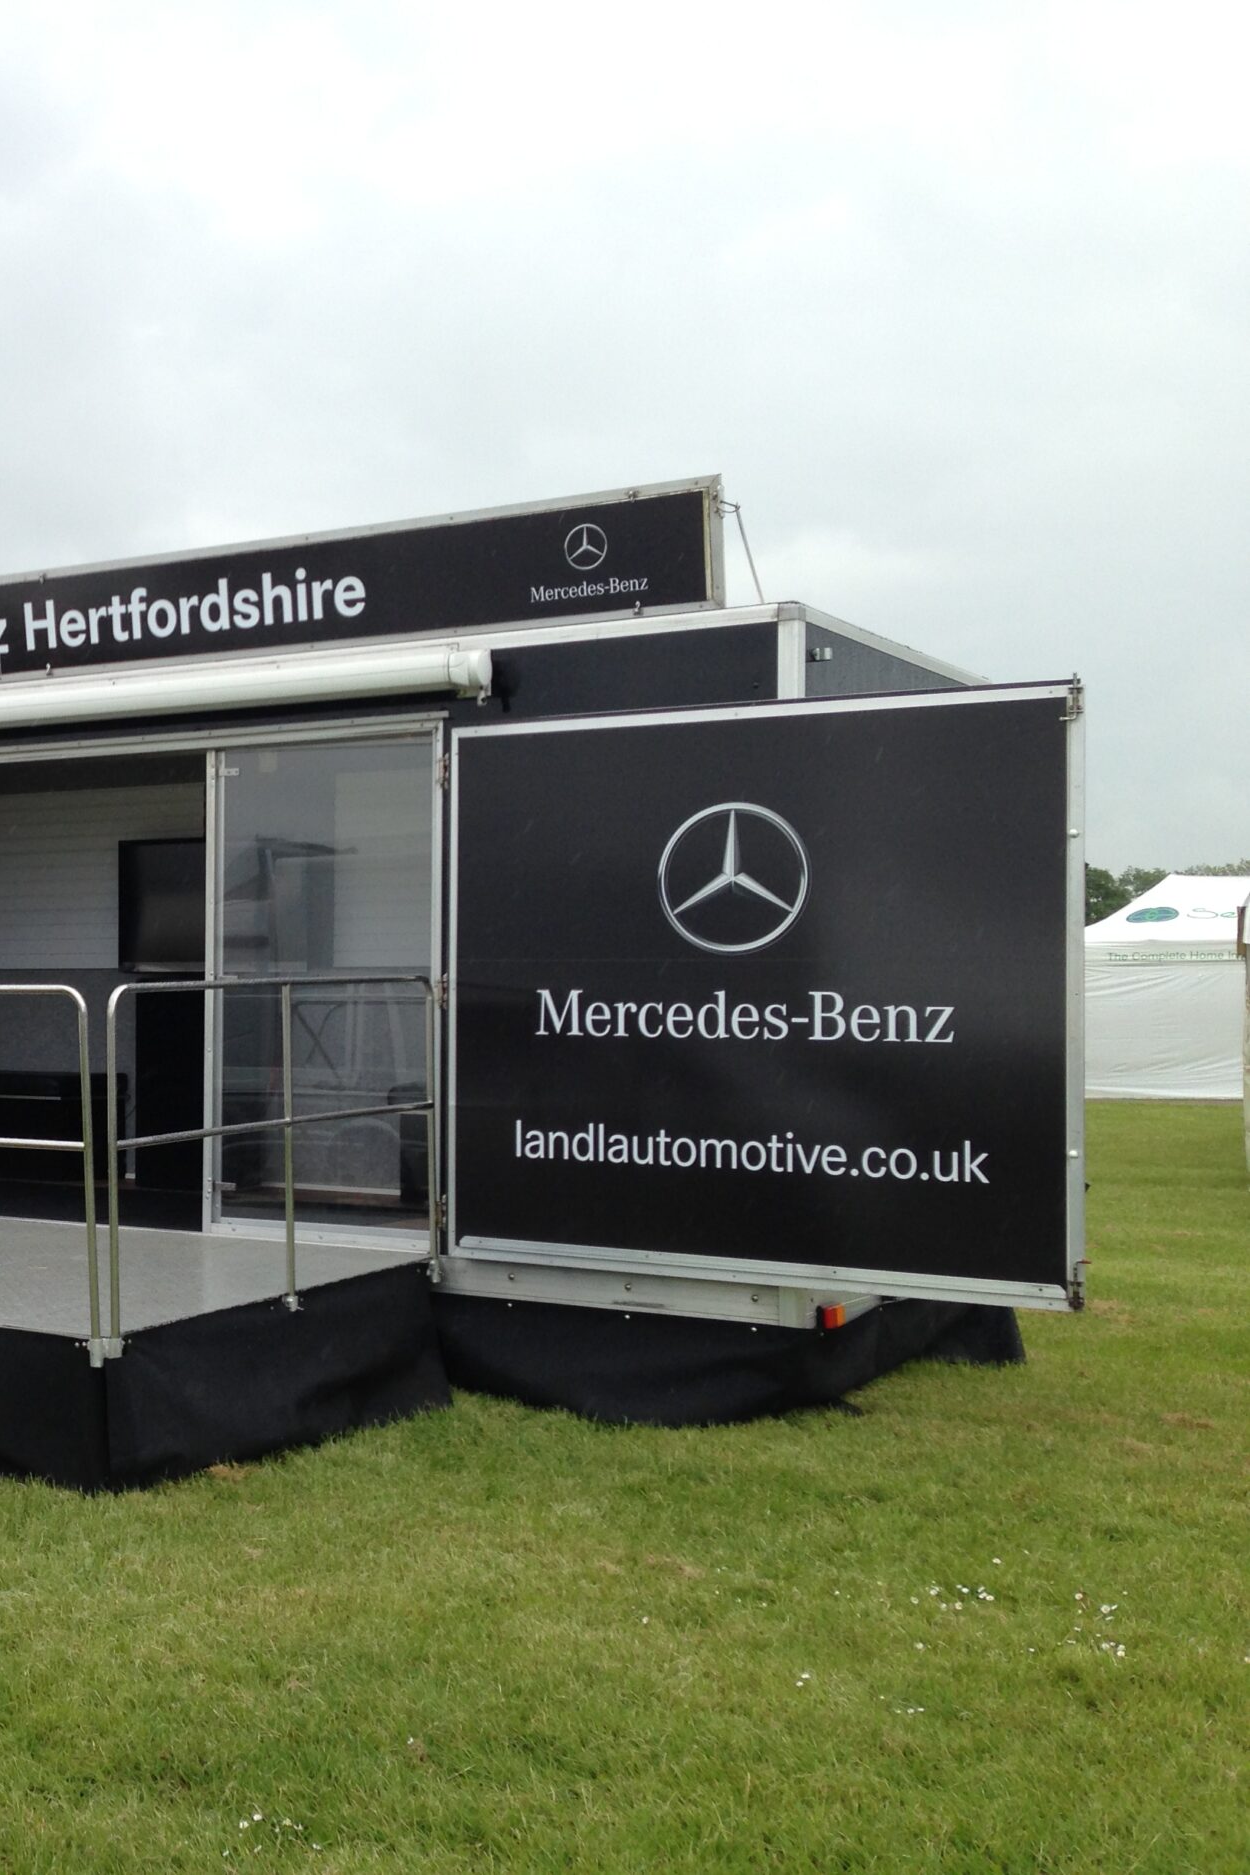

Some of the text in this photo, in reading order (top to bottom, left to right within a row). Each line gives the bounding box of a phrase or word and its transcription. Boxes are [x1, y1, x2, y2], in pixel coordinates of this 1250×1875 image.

[23, 567, 366, 651] Hertfordshire
[530, 577, 649, 603] Mercedes-Benz
[1108, 951, 1129, 962] The
[1131, 951, 1187, 962] Complete
[1190, 950, 1225, 960] Home
[535, 989, 955, 1044] Mercedes-Benz
[515, 1120, 990, 1185] landlautomotive.co.uk
